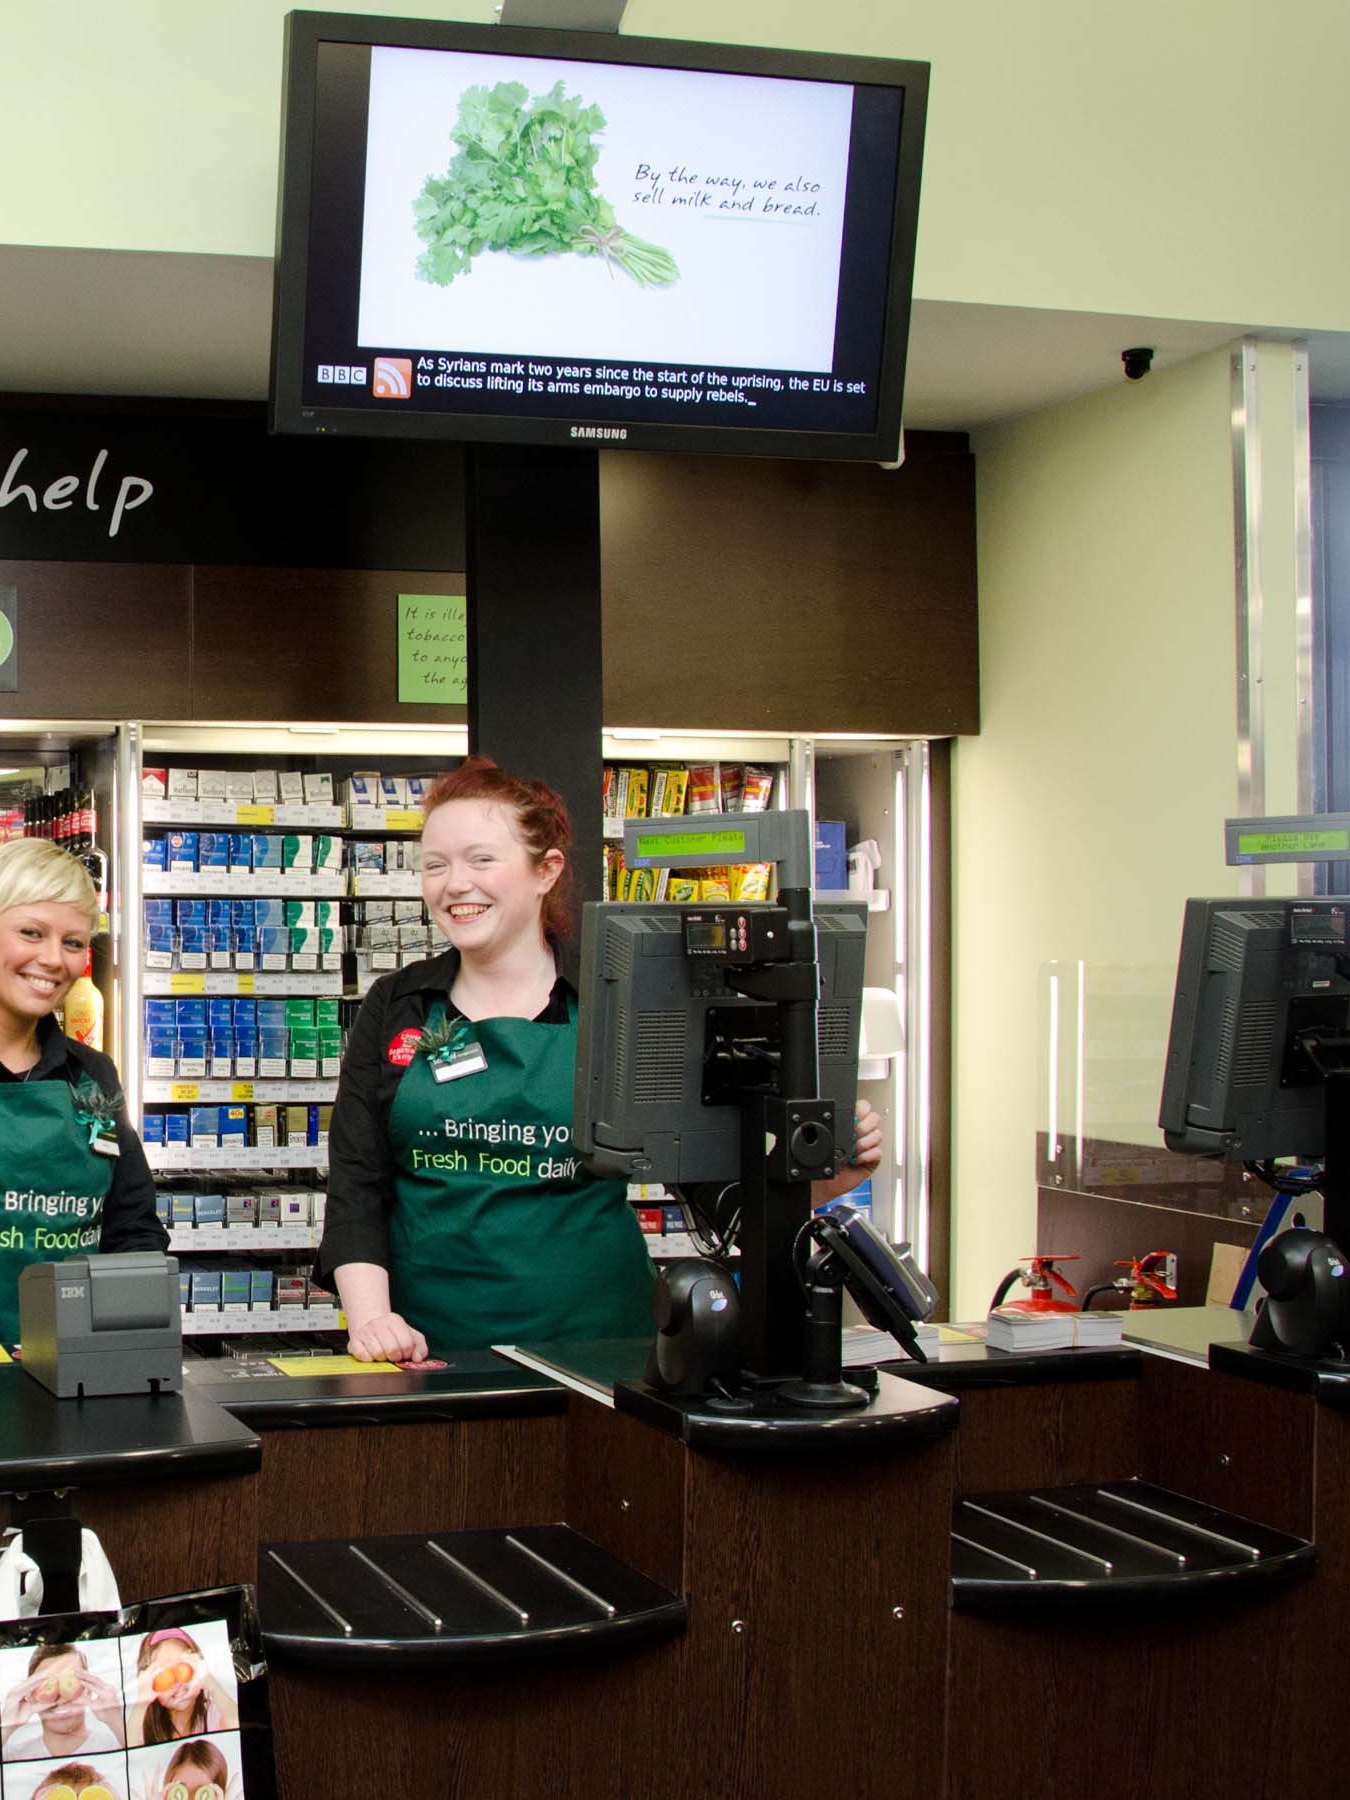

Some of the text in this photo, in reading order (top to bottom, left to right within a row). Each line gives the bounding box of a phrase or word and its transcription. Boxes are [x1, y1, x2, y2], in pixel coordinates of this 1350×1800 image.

[635, 164, 661, 190] By
[669, 166, 698, 184] the
[753, 178, 777, 190] we
[784, 175, 821, 193] also
[633, 187, 821, 217] sell milk and bread.
[318, 365, 367, 385] BBC
[416, 356, 866, 395] As Syrians mark two years since the start of the uprising, the EU is set
[416, 373, 431, 387] to
[434, 373, 482, 389] discuss
[486, 376, 524, 394] lifting
[528, 377, 544, 392] its
[547, 382, 580, 395] arms
[583, 381, 641, 400] embargo
[644, 384, 658, 398] to
[661, 387, 702, 404] supply
[570, 426, 628, 441] SAMSUNG
[405, 607, 418, 619] It
[425, 608, 436, 619] is
[407, 628, 466, 642] tobacco
[411, 649, 428, 662] to
[421, 671, 447, 685] the
[444, 1117, 537, 1146] Bringing
[542, 1125, 573, 1148] yo
[412, 1148, 583, 1181] Fresh Food daily
[4, 1189, 89, 1216] Bringing
[34, 1227, 81, 1250] Food
[60, 1287, 85, 1299] IBM
